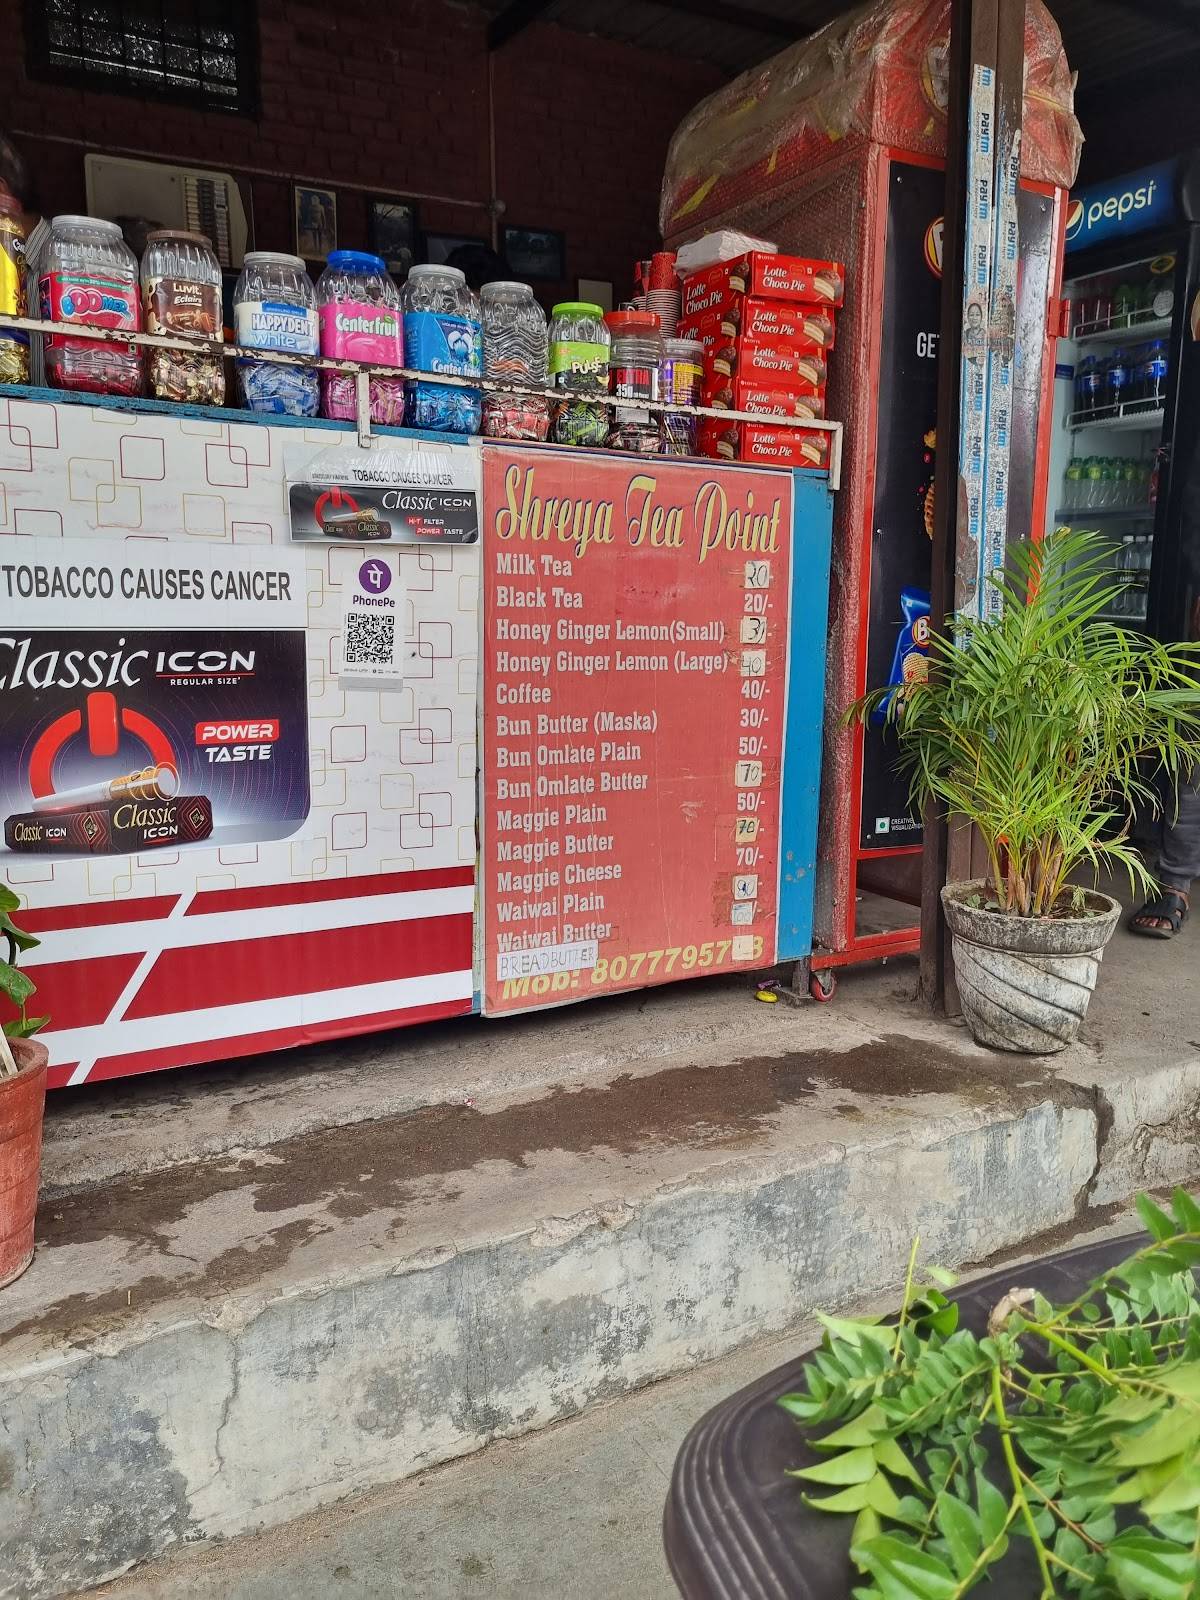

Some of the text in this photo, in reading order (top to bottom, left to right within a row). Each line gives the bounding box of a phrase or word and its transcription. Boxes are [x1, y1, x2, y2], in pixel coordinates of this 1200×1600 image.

[1088, 180, 1153, 229] pepsi
[764, 265, 787, 277] Lotte
[687, 283, 706, 300] Lotte
[763, 277, 805, 291] Choco Pie
[686, 290, 724, 315] Choco Pie
[252, 313, 314, 337] HAPPYDENT
[753, 310, 777, 321] Lotte
[752, 322, 795, 336] Choco Pie
[753, 346, 775, 357] Lotte
[916, 332, 940, 358] GE
[752, 357, 793, 371] Choco Pie
[747, 391, 769, 402] Lotte
[746, 402, 787, 416] Choco Pie
[753, 432, 775, 443] Lotte
[752, 444, 792, 456] Choco Pie
[352, 470, 390, 482] TOBACCO
[392, 472, 421, 484] CAUSES
[423, 474, 454, 486] CANCER
[382, 490, 472, 511] Classic ICON
[495, 464, 781, 564] Shreya Tea Point
[496, 553, 573, 577] Milk Tea
[2, 565, 292, 601] TOBACCO CAUSES CANCER
[352, 595, 395, 608] PhonePe
[496, 586, 773, 615] Black Tea 20/-
[496, 619, 725, 647] Honey Ginger Lemon(Small)
[156, 651, 256, 672] ICON
[496, 651, 728, 677] Honey Ginger Lemon (Large)
[170, 678, 214, 686] REGULAR
[496, 680, 770, 704] Coffee 40/-
[202, 724, 274, 741] POWER
[496, 708, 769, 737] Bun Butter (Maska) 30/-
[205, 744, 273, 763] TASTE
[496, 736, 768, 768] Bun Omlate Plain 50/-
[496, 772, 648, 800] Bun Omlate Butter
[114, 802, 177, 829] Classic
[496, 792, 765, 832] Maggie Plain 50/-
[14, 821, 67, 842] Classic ICON
[143, 825, 178, 839] ICON
[496, 833, 614, 863] Maggie Butter
[496, 847, 764, 894] Maggie Cheese 70/-
[496, 894, 605, 922] Waiwai Plain
[496, 922, 612, 953] Waiwai Butter
